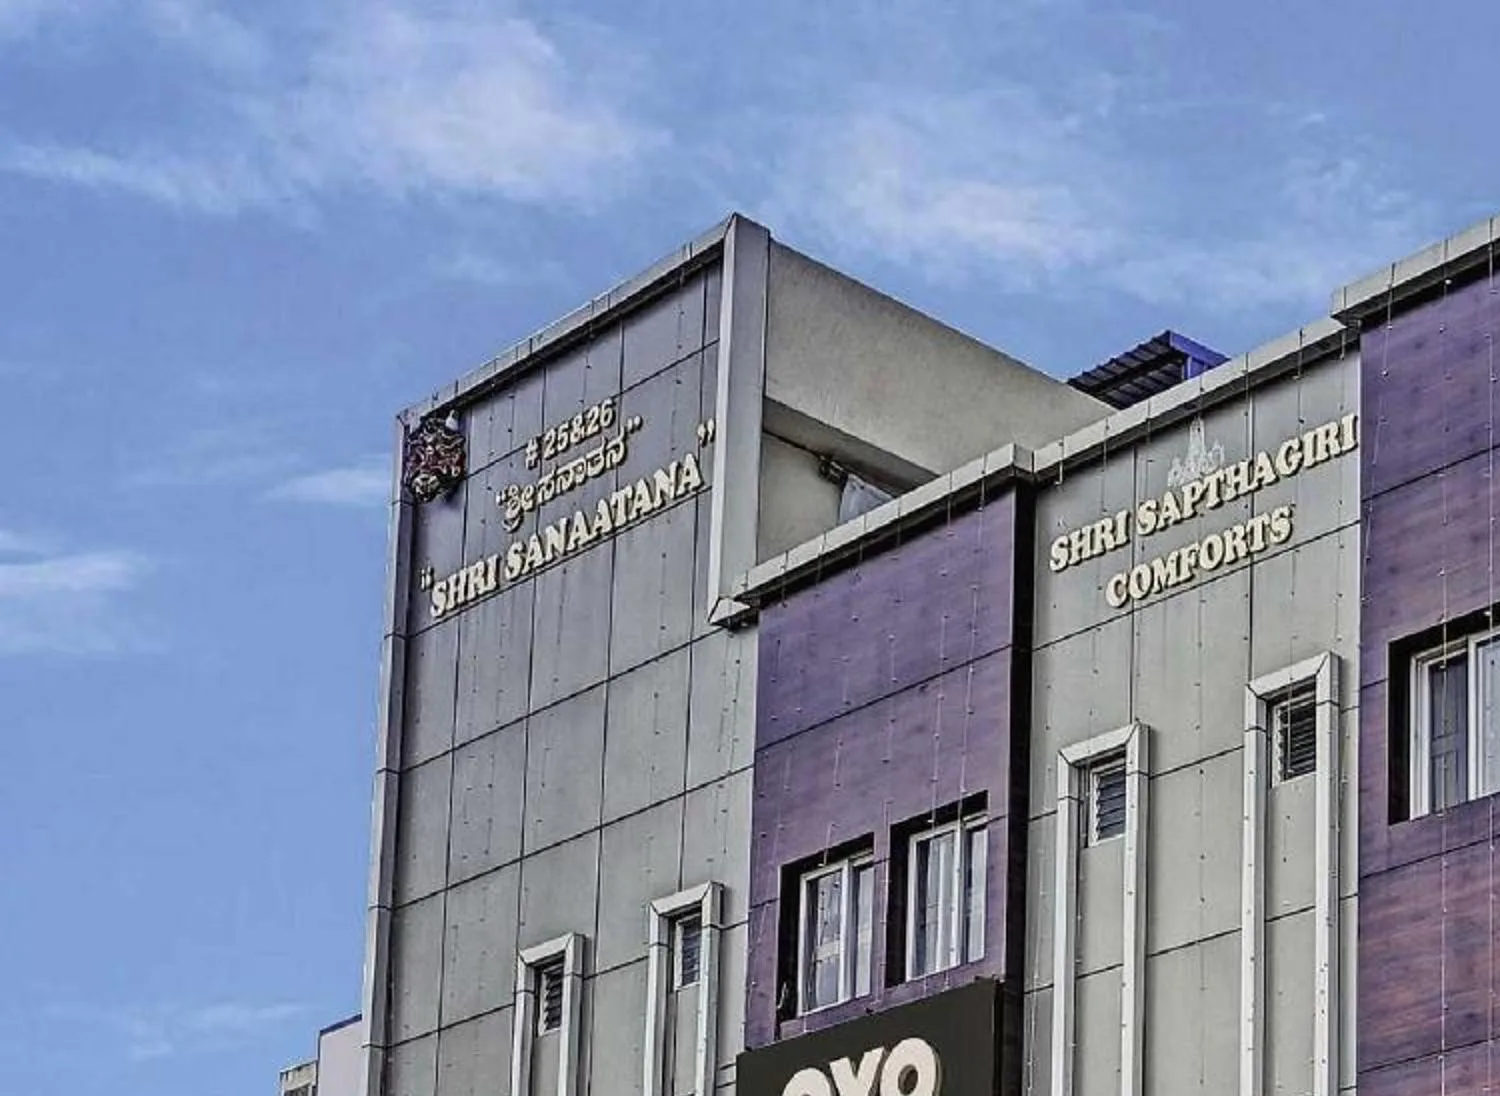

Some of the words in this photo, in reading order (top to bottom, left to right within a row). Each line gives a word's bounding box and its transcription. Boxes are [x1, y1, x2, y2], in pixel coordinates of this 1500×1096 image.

[1049, 510, 1131, 572] SHRI
[1135, 413, 1359, 537] SAPTHAGIRI
[1105, 506, 1295, 608] COMFORTS
